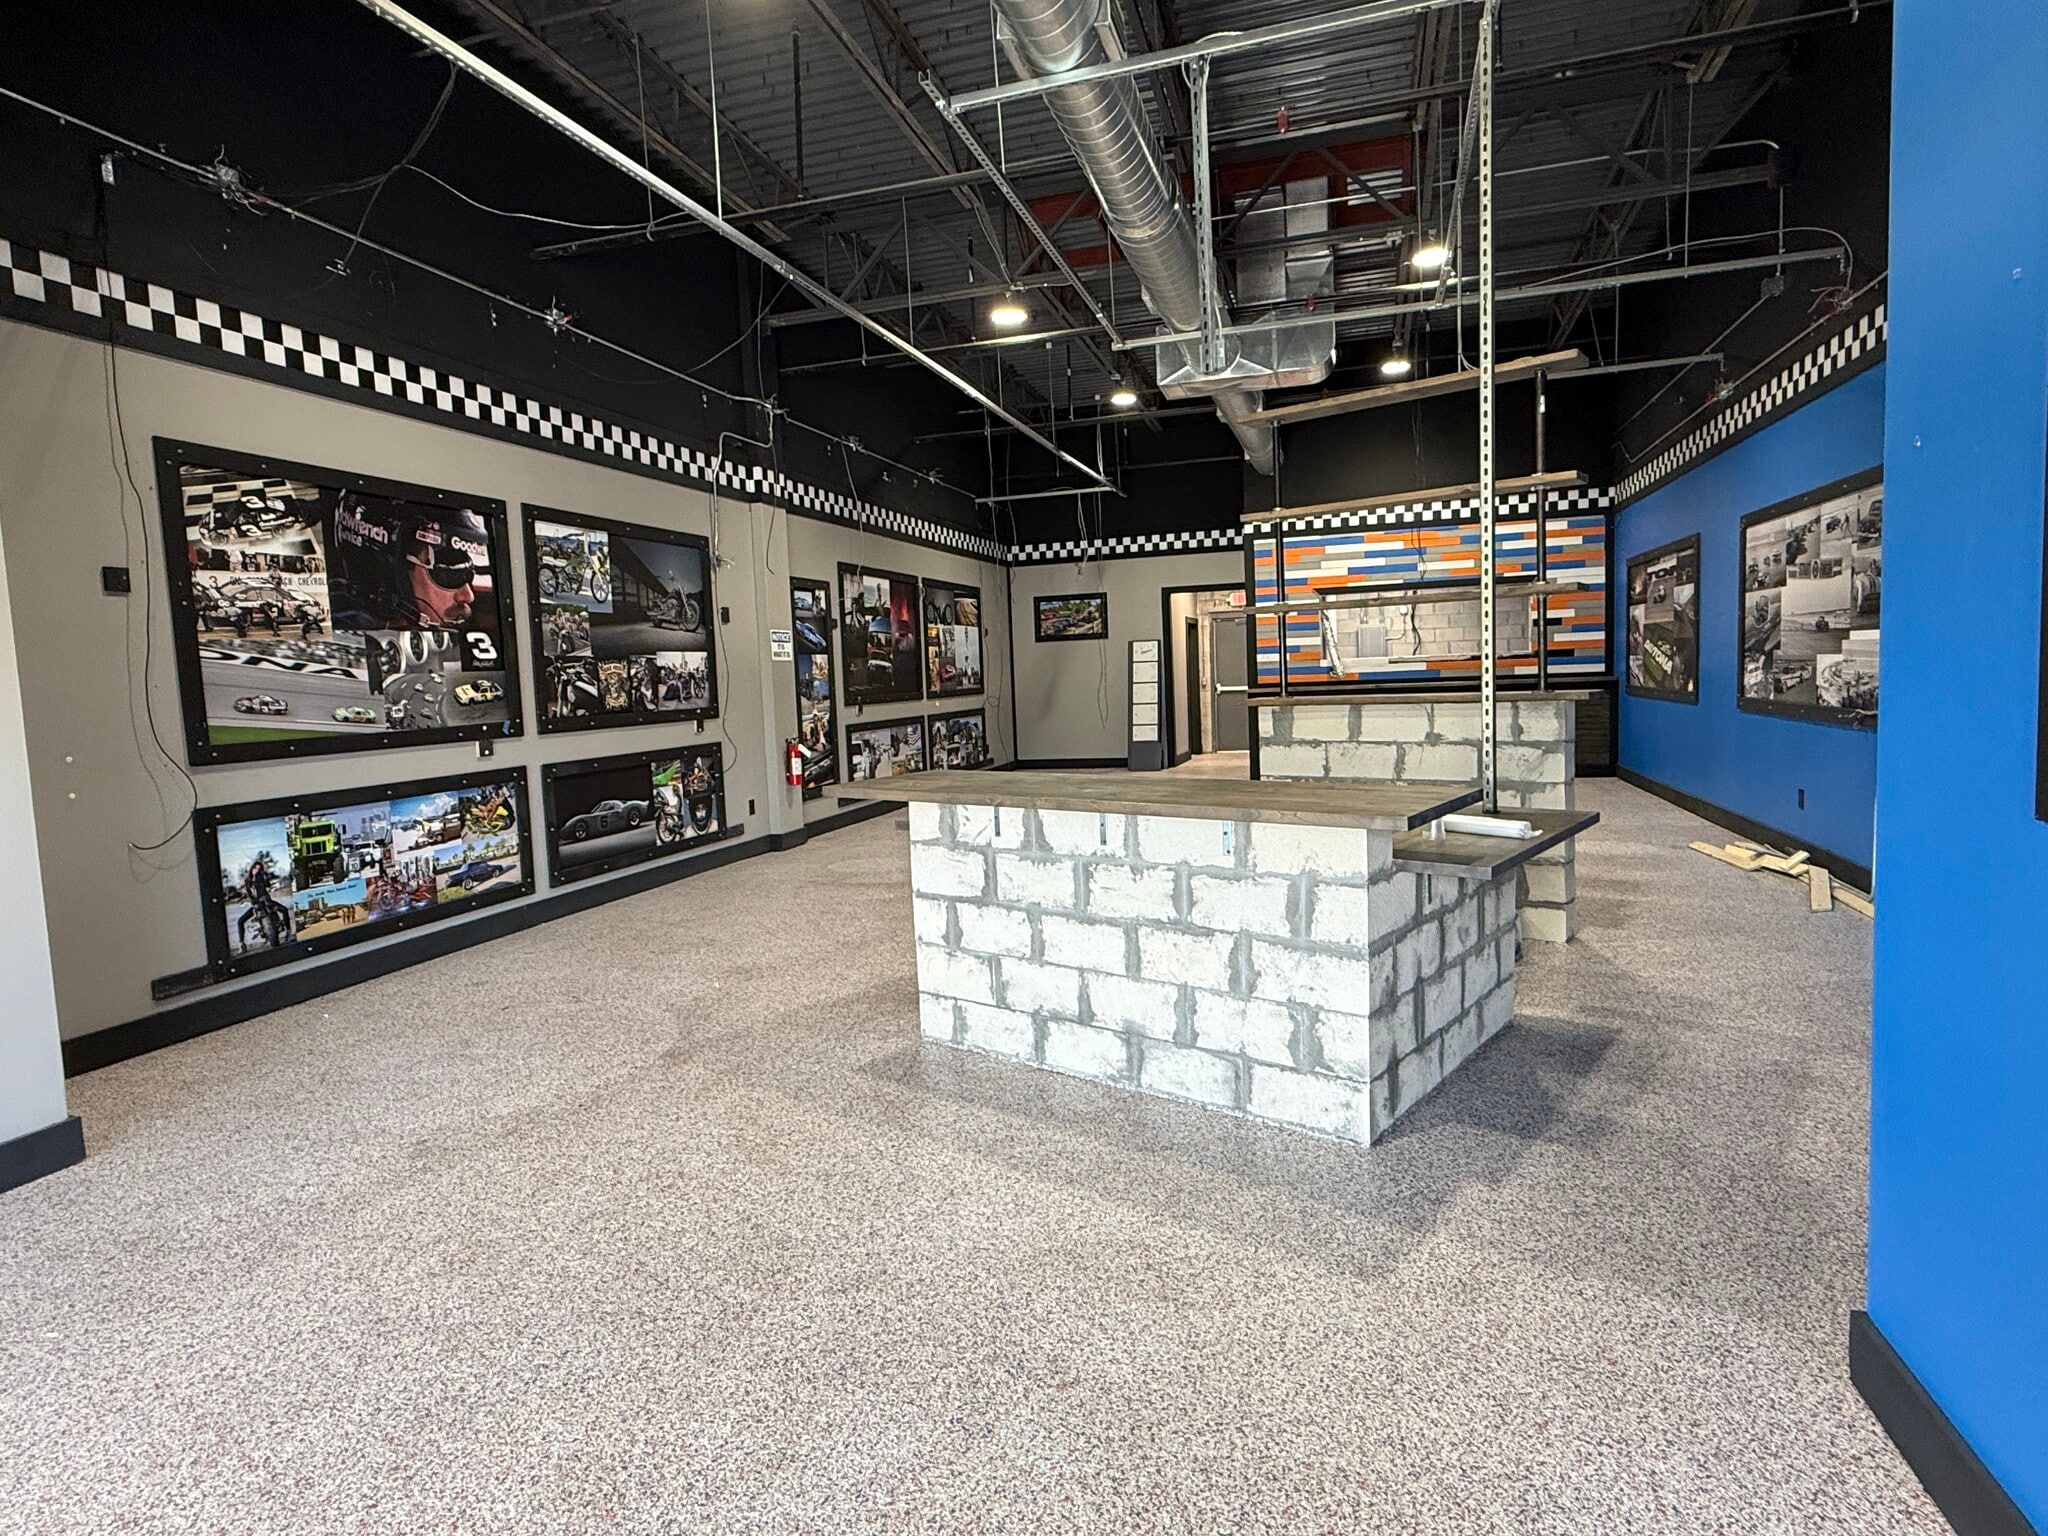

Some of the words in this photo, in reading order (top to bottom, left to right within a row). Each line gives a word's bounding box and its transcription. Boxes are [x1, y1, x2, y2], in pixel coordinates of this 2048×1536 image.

[240, 495, 265, 508] 3
[240, 524, 262, 537] 3
[466, 631, 498, 660] 3
